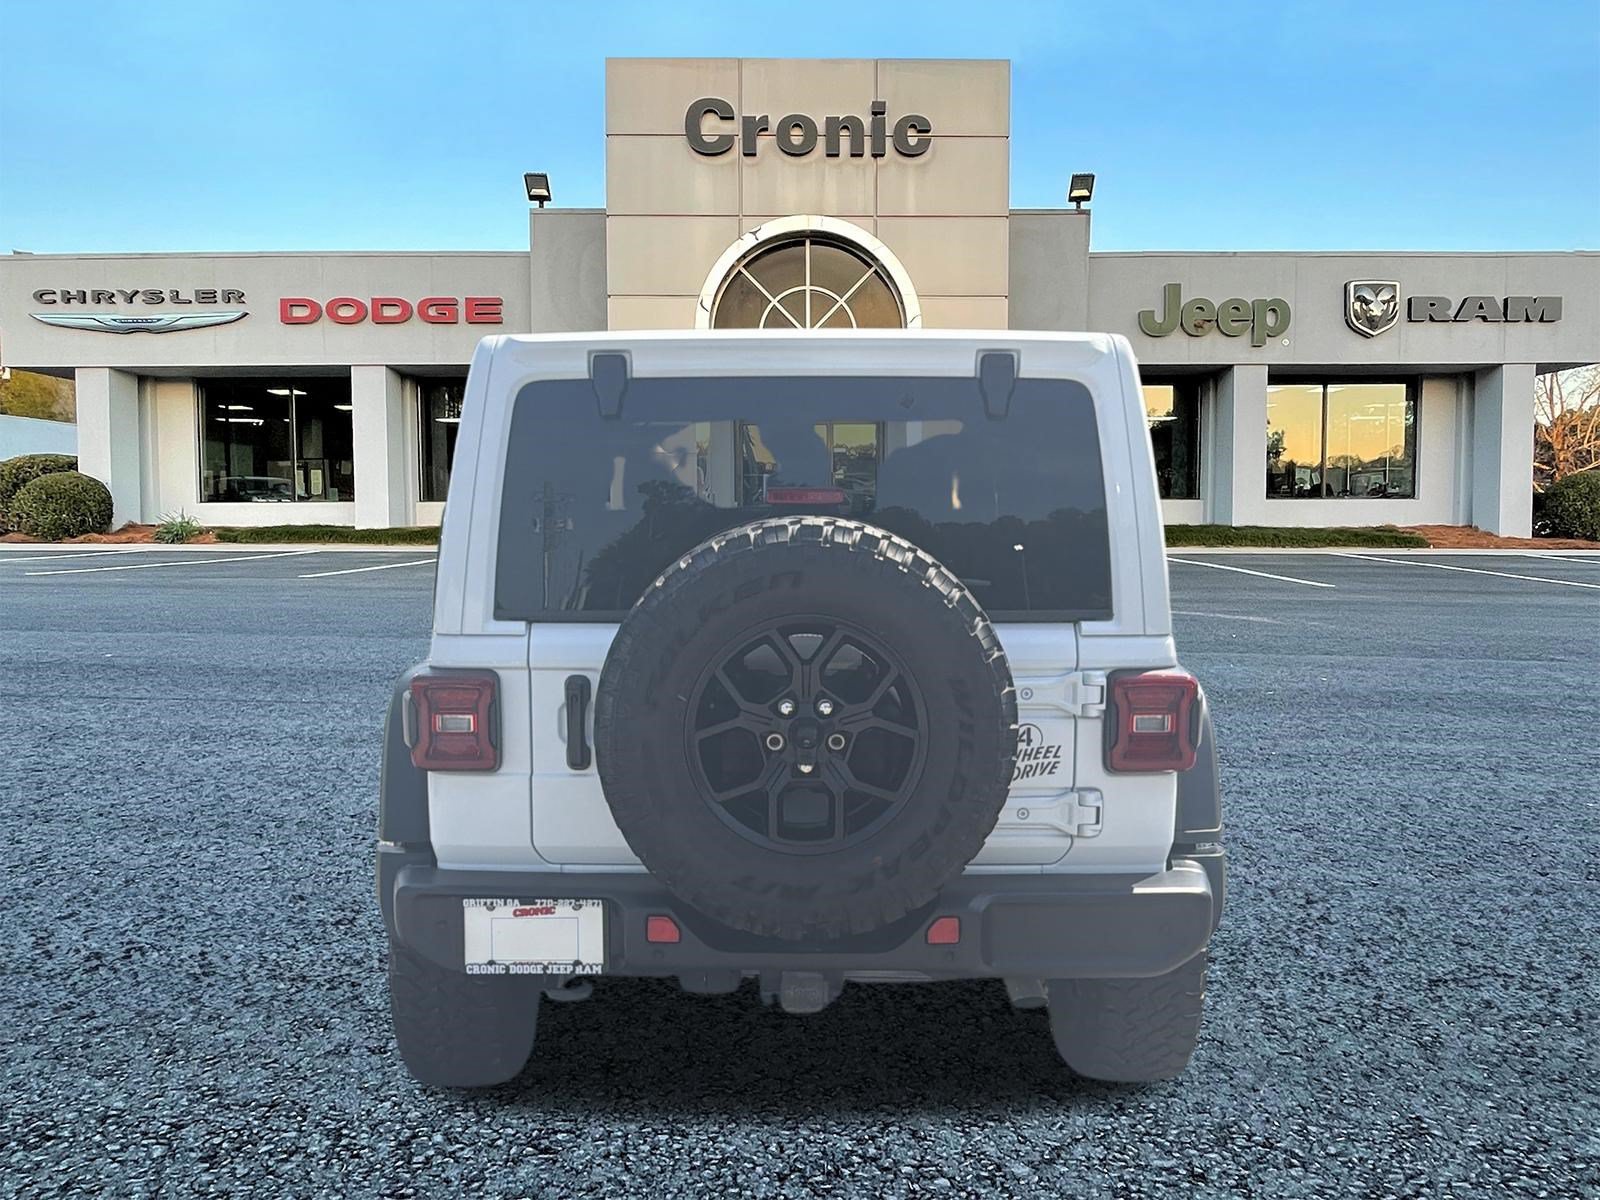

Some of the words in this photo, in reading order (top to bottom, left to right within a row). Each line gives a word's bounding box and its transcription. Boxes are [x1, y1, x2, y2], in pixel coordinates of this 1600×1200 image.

[685, 97, 932, 157] Cronic
[32, 288, 247, 305] CHRYSLER
[1407, 296, 1562, 323] RAM
[280, 296, 503, 325] DODGE
[1138, 283, 1291, 347] Jeep
[1017, 727, 1033, 746] 4
[466, 964, 506, 975] CRONIC
[509, 964, 544, 974] DODGE
[546, 964, 573, 974] JEEP
[575, 964, 602, 974] RAM
